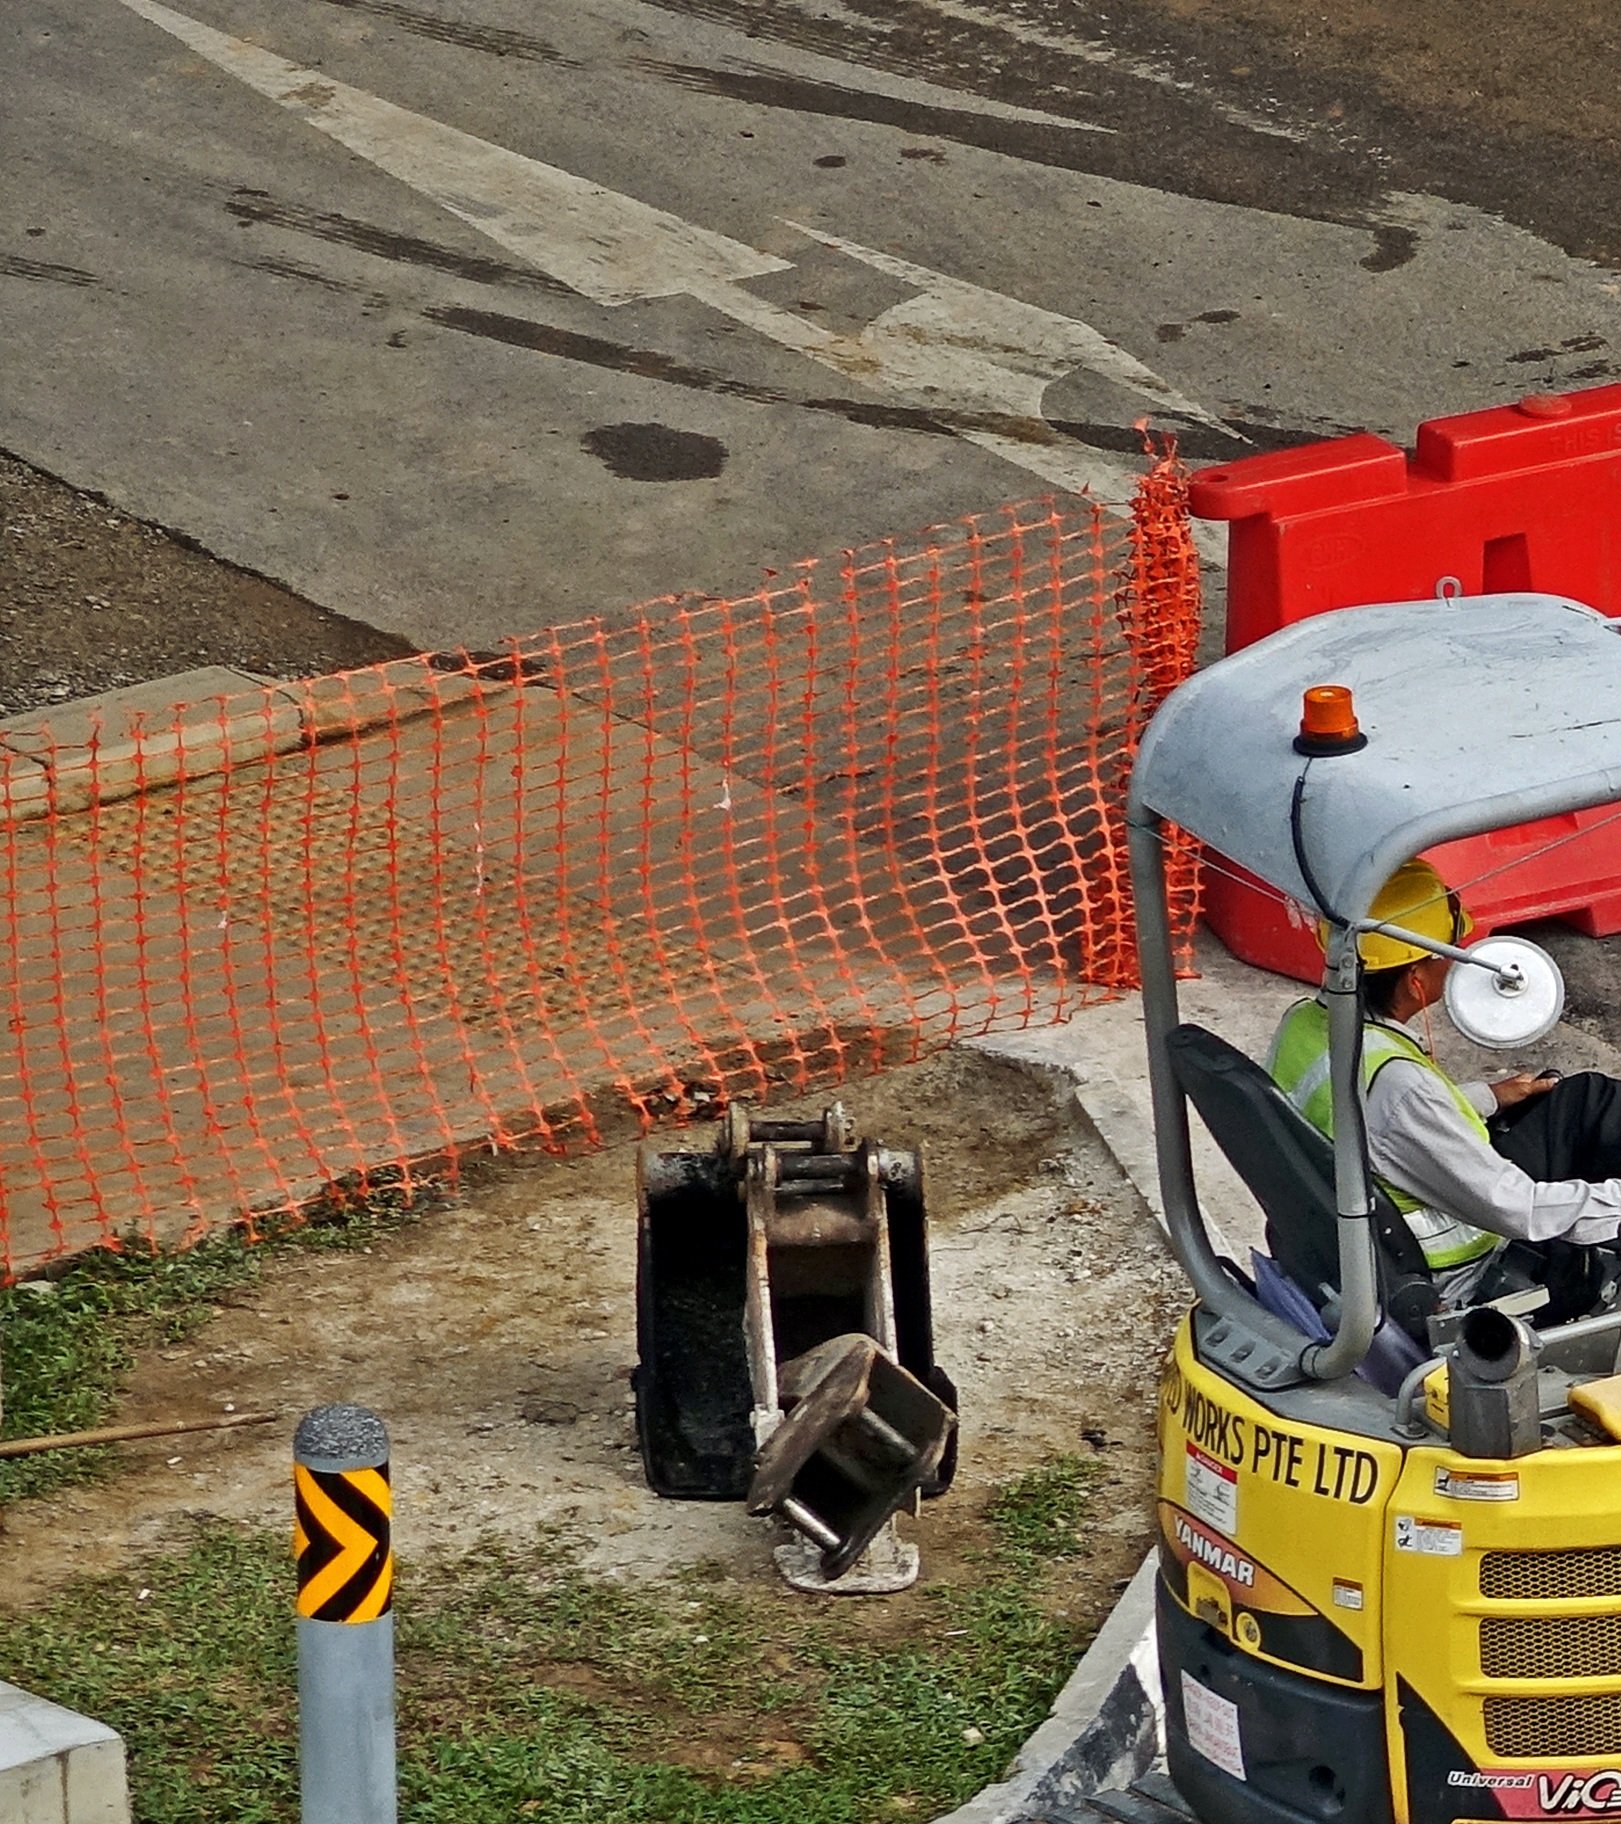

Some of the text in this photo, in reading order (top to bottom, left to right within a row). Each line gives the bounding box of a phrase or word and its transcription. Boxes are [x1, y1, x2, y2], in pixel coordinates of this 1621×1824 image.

[1550, 427, 1600, 456] THIS
[1181, 1380, 1245, 1466] WORKS
[1252, 1423, 1304, 1488] PTE
[1313, 1443, 1378, 1504] LTD
[1174, 1515, 1255, 1587] YANMAR
[1447, 1770, 1536, 1788] Universal
